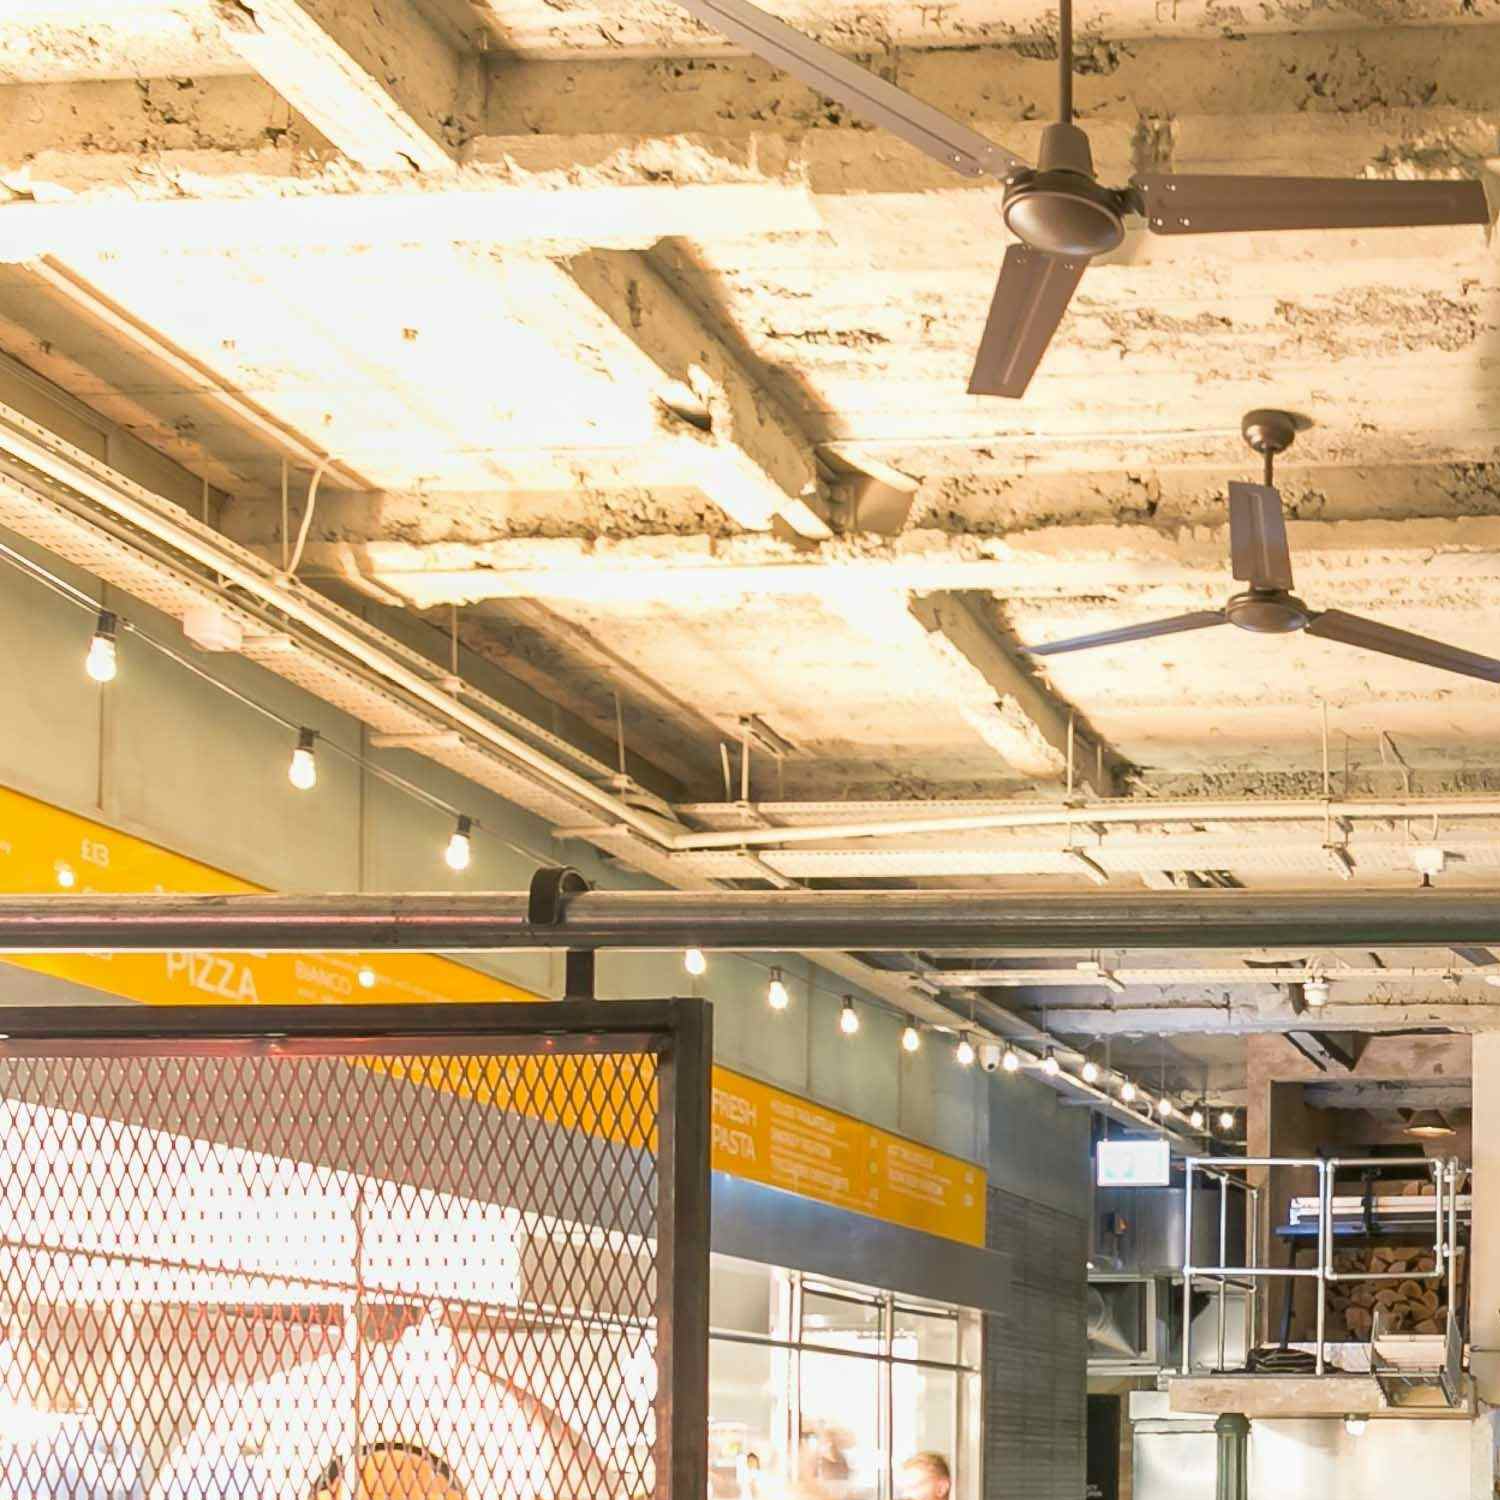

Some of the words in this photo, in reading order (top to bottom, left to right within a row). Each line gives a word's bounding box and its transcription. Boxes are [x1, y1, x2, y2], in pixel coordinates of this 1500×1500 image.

[166, 951, 259, 1003] PIZZA
[712, 1087, 758, 1128] FRESH
[712, 1121, 757, 1161] PASTA
